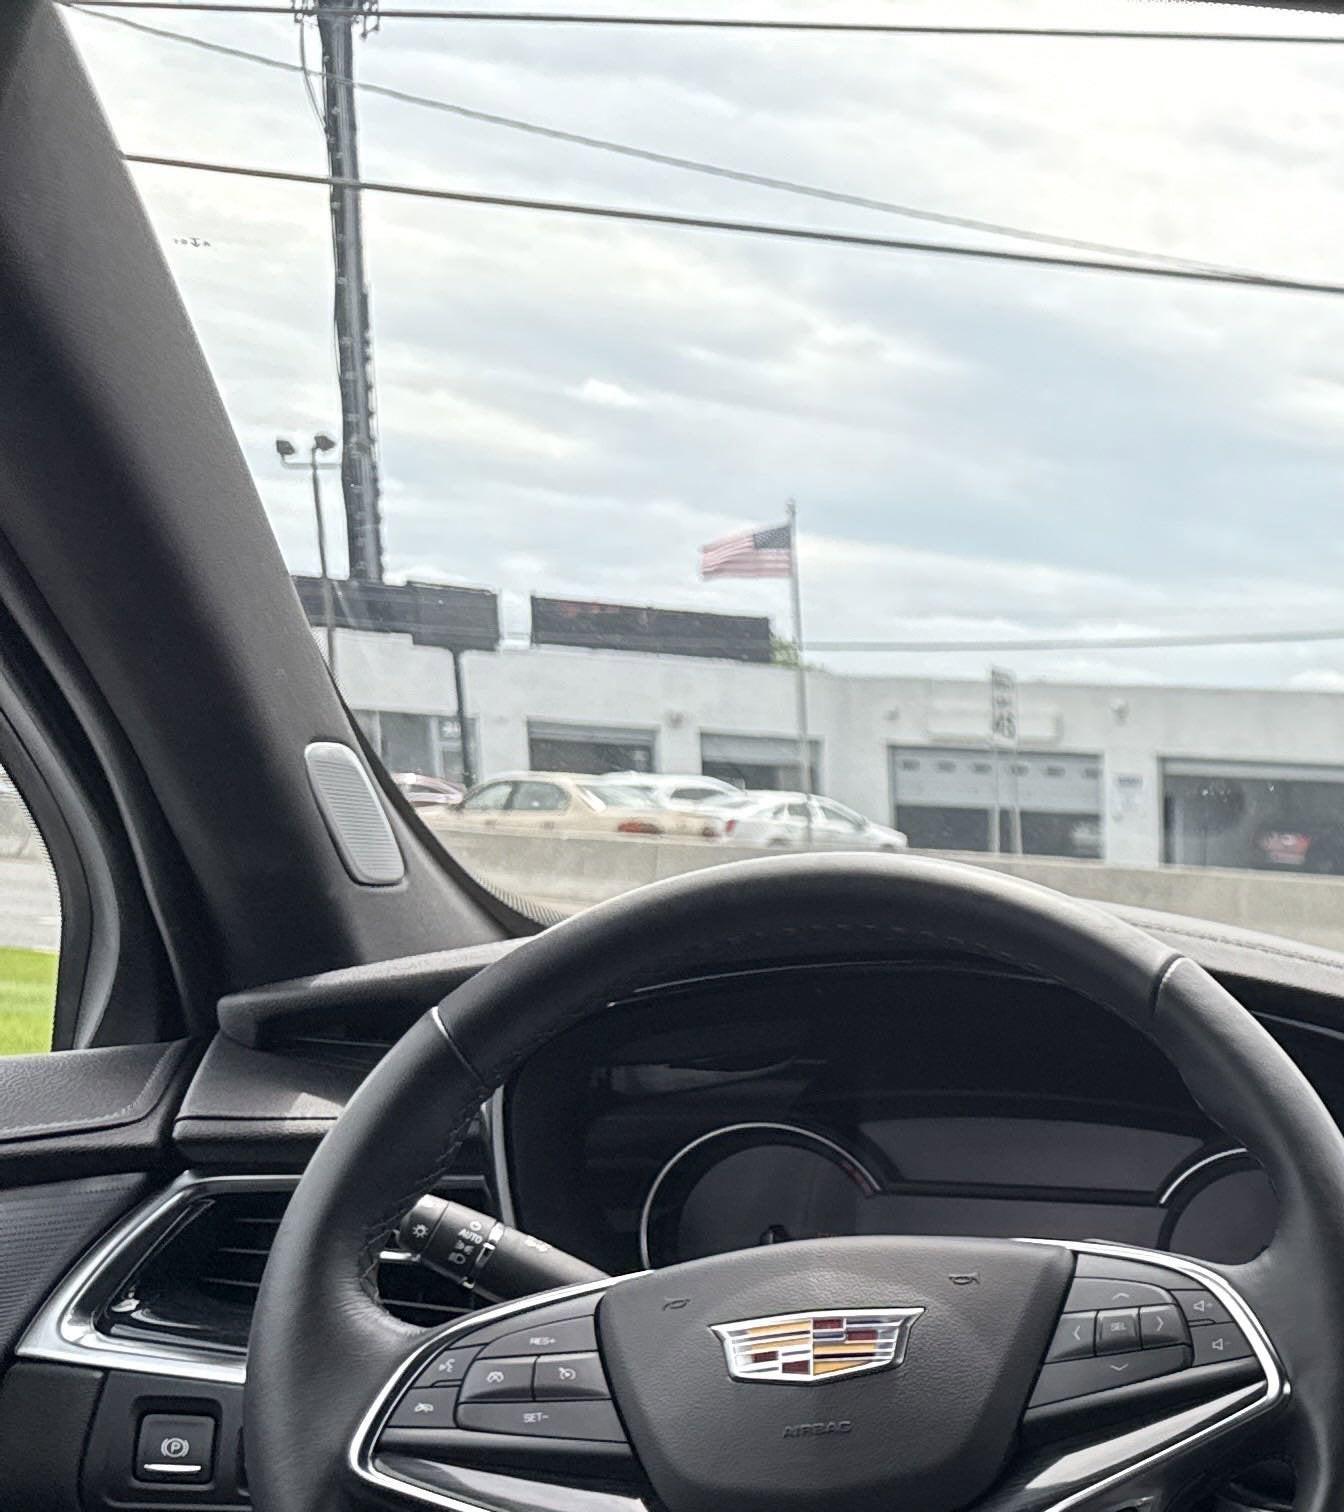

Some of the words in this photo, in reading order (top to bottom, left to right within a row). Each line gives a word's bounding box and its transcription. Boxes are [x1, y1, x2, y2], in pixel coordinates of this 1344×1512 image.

[457, 1228, 483, 1245] AUTO
[529, 1336, 556, 1346] RES+
[523, 1411, 549, 1423] SET-
[783, 1420, 852, 1438] AIRBAG
